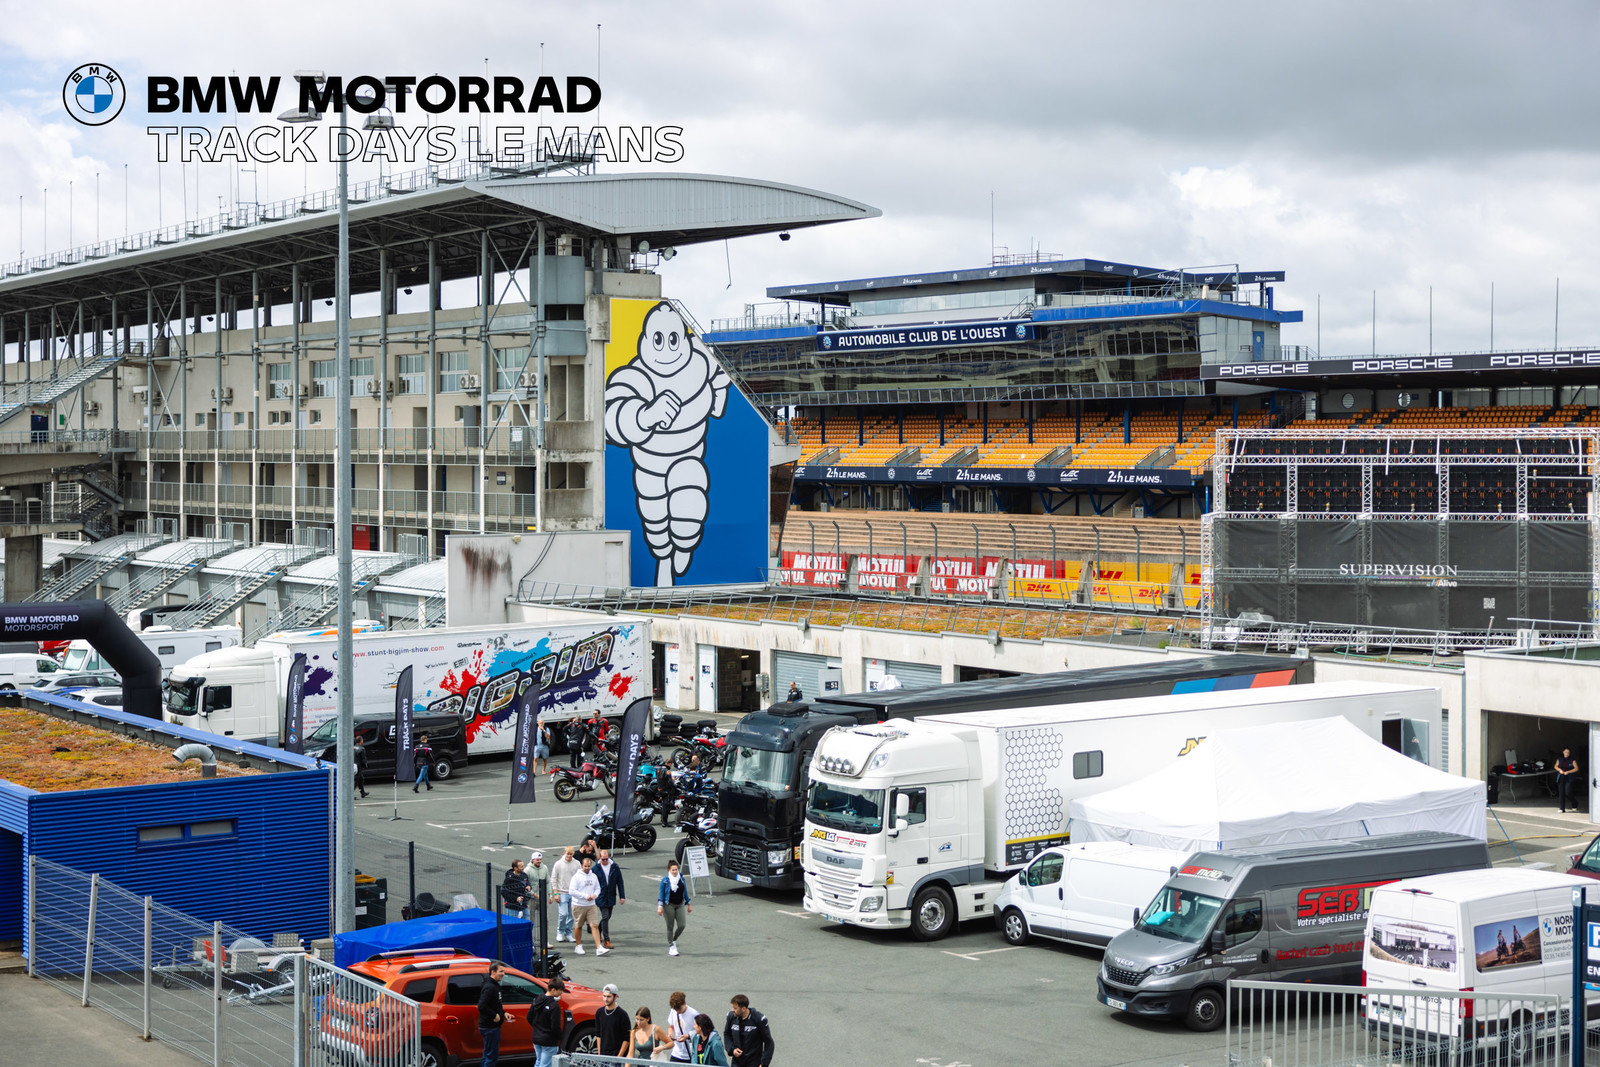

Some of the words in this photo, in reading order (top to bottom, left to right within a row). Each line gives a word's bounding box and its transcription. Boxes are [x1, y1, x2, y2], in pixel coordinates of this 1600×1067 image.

[838, 333, 906, 347] AUTOMOBILE
[909, 331, 938, 343] CLUB
[942, 330, 957, 341] DE
[961, 327, 1007, 340] L'OUEST
[1352, 358, 1453, 371] PORSCHE
[1490, 352, 1600, 367] PORSCHE
[1219, 363, 1309, 376] PORSCHE
[1339, 563, 1458, 576] SUPERVISION
[1027, 583, 1052, 592] DHL
[1438, 579, 1458, 587] Alive
[4, 616, 28, 624] BMW
[29, 614, 79, 624] MOTORRAD
[4, 623, 65, 632] MOTORSPORT
[629, 733, 639, 760] DAYS
[826, 855, 845, 865] DAF
[1572, 890, 1580, 901] P
[1297, 888, 1360, 918] SEB
[1297, 917, 1316, 927] Votre
[1555, 925, 1574, 936] MOT
[1309, 943, 1331, 957] cash
[1333, 941, 1353, 954] tout
[1114, 956, 1135, 966] IVECO
